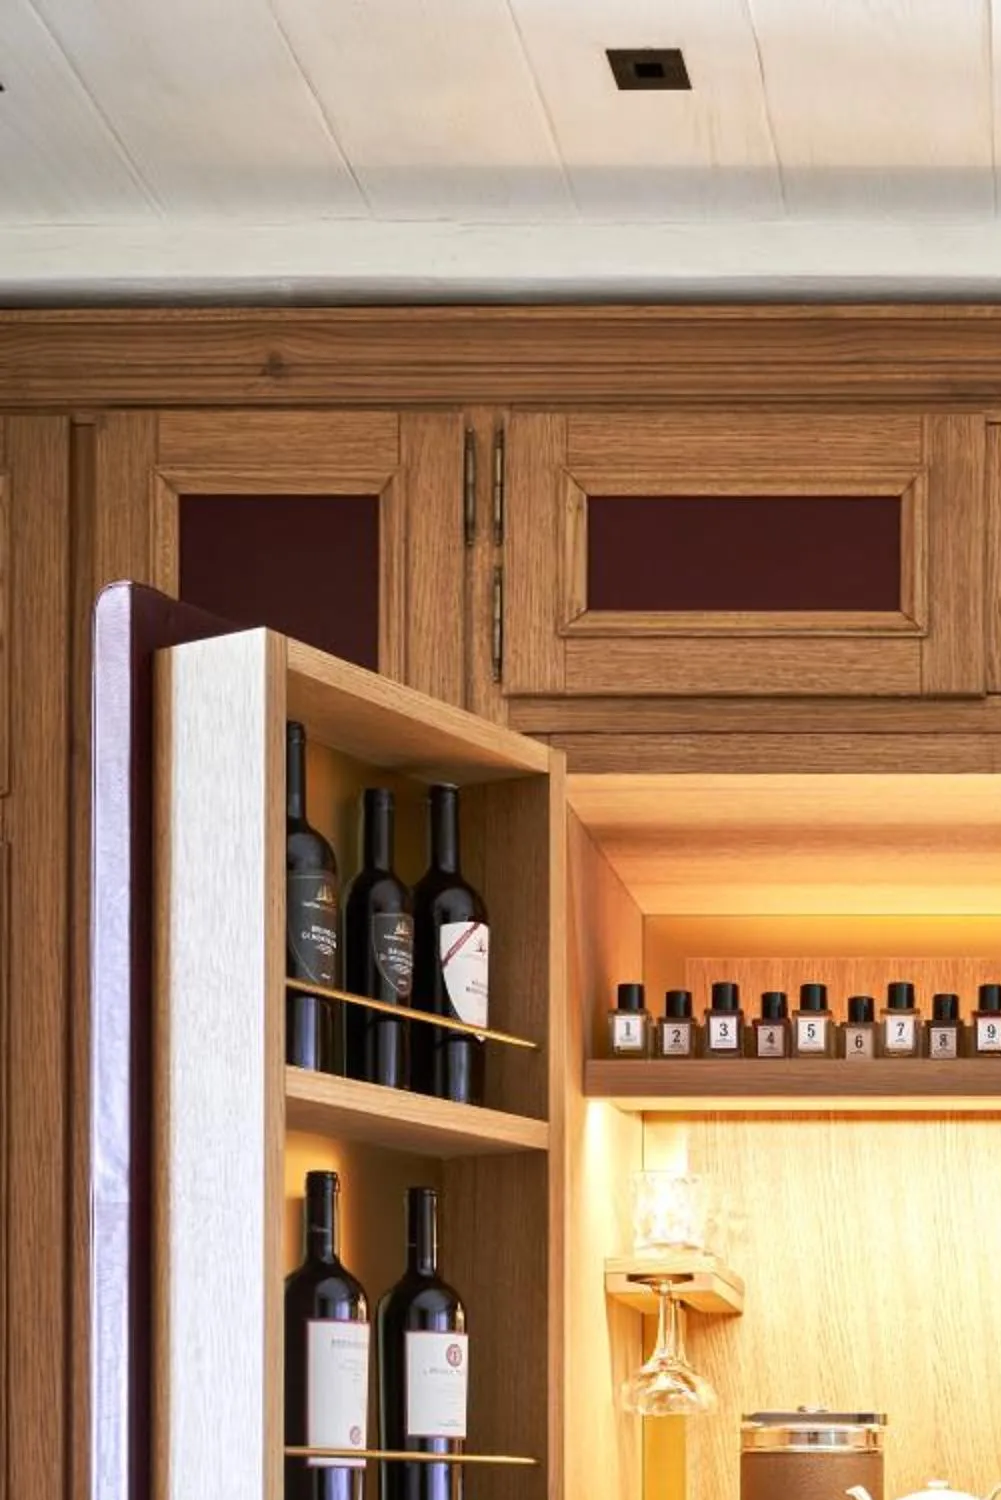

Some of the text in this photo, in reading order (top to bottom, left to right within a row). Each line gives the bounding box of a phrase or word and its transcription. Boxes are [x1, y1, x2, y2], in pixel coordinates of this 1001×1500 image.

[672, 1029, 681, 1043] 2
[719, 1023, 729, 1037] 3
[807, 1023, 816, 1039] 5
[896, 1022, 905, 1037] 7
[987, 1024, 996, 1039] 9
[766, 1031, 775, 1045] 4
[855, 1035, 863, 1049] 6
